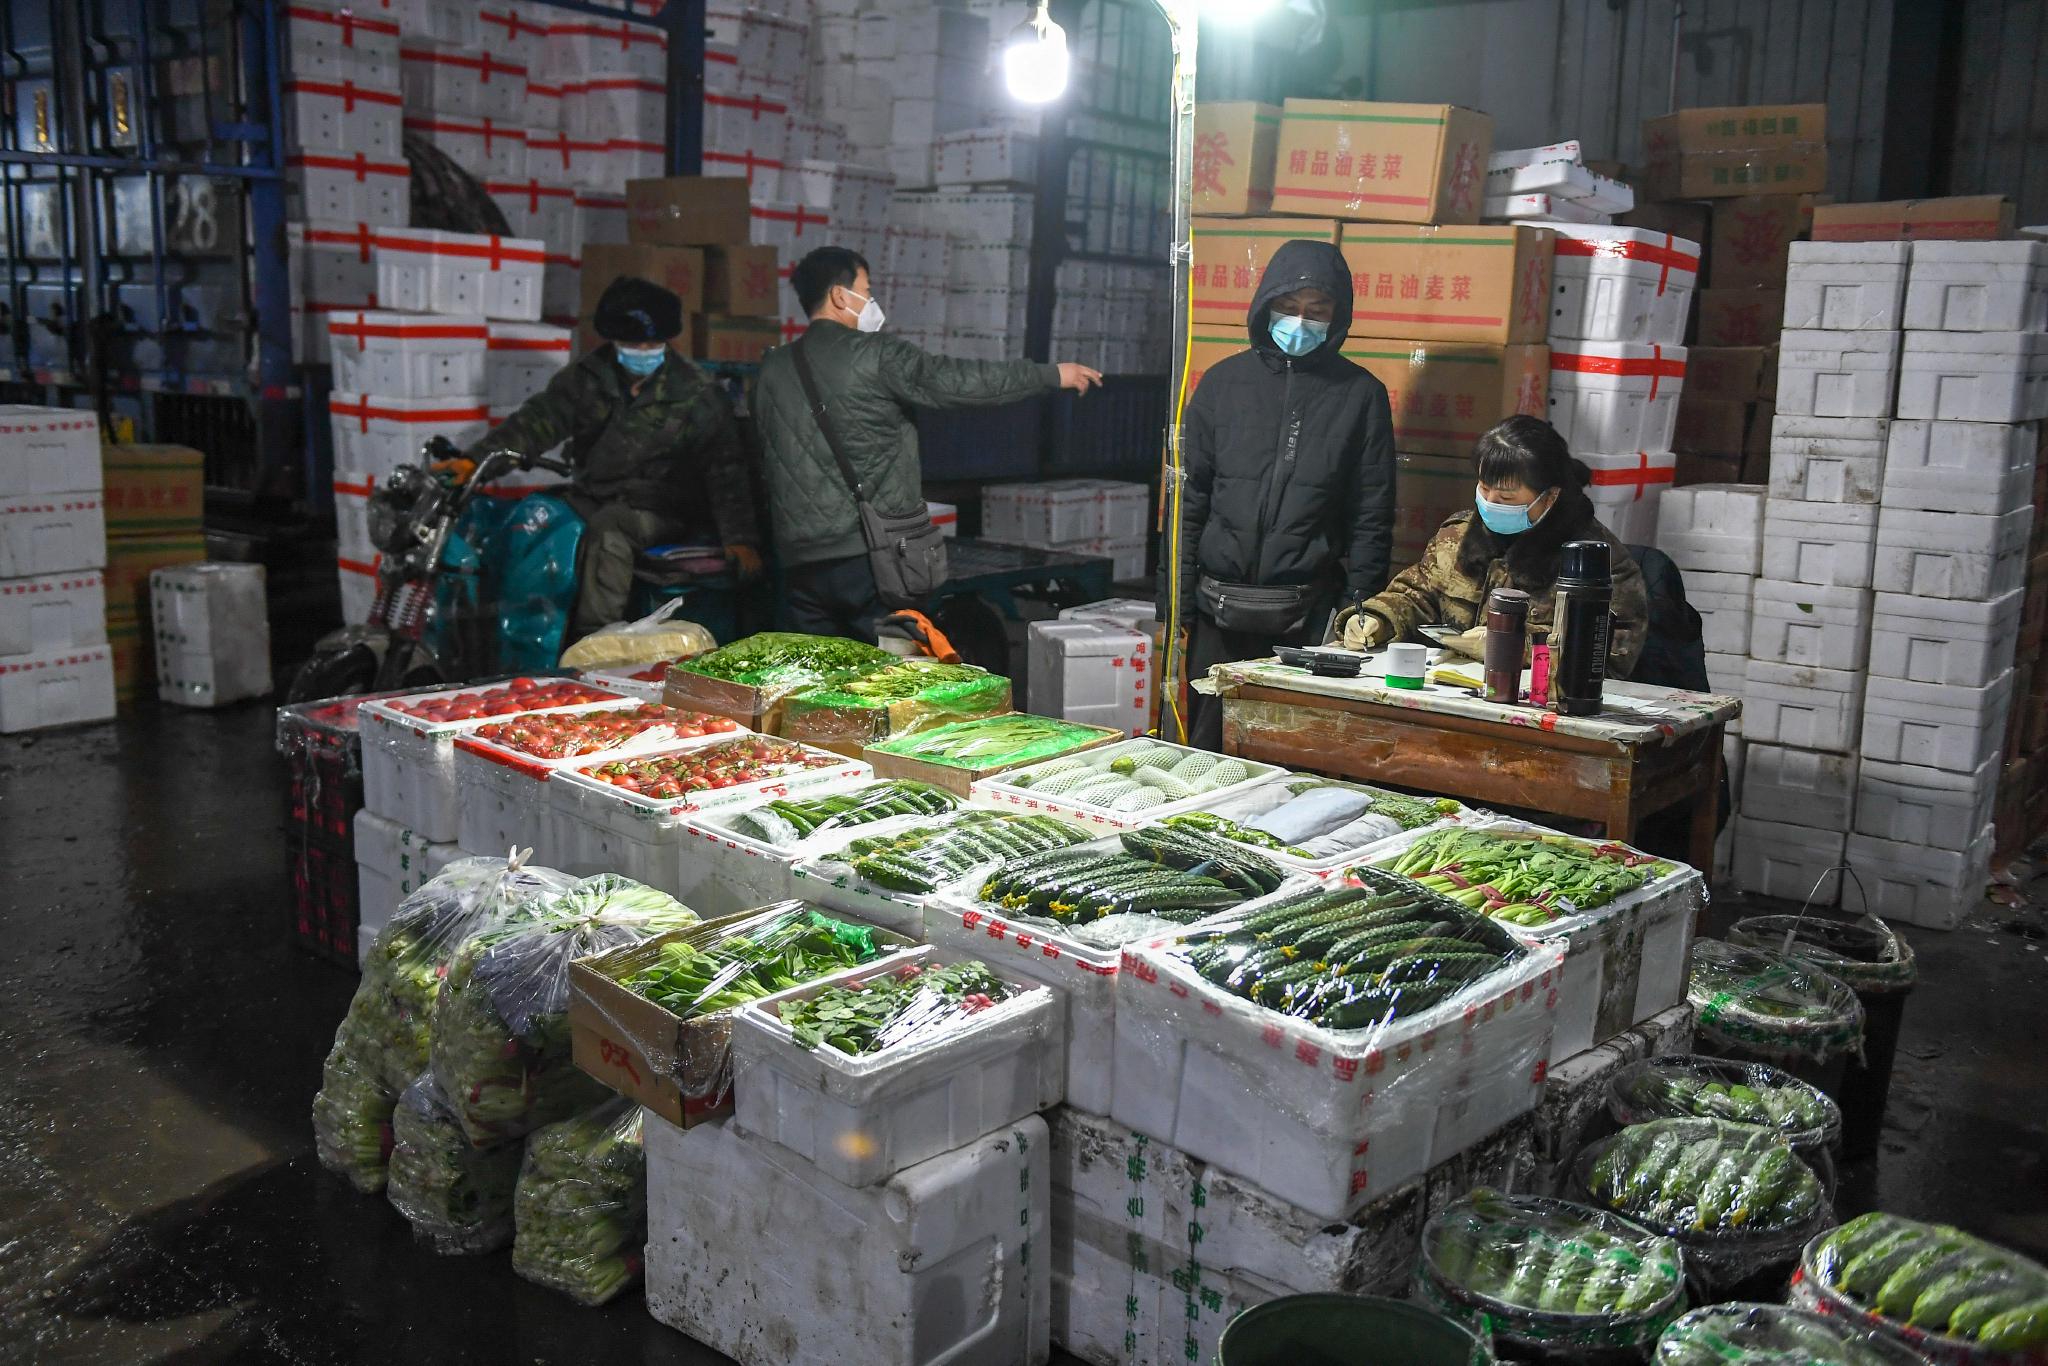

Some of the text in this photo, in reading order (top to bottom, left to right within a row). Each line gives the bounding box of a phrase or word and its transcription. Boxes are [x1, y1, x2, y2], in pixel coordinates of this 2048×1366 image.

[1289, 149, 1403, 181] 精品油麦菜
[1353, 271, 1473, 302] 精品油麦菜
